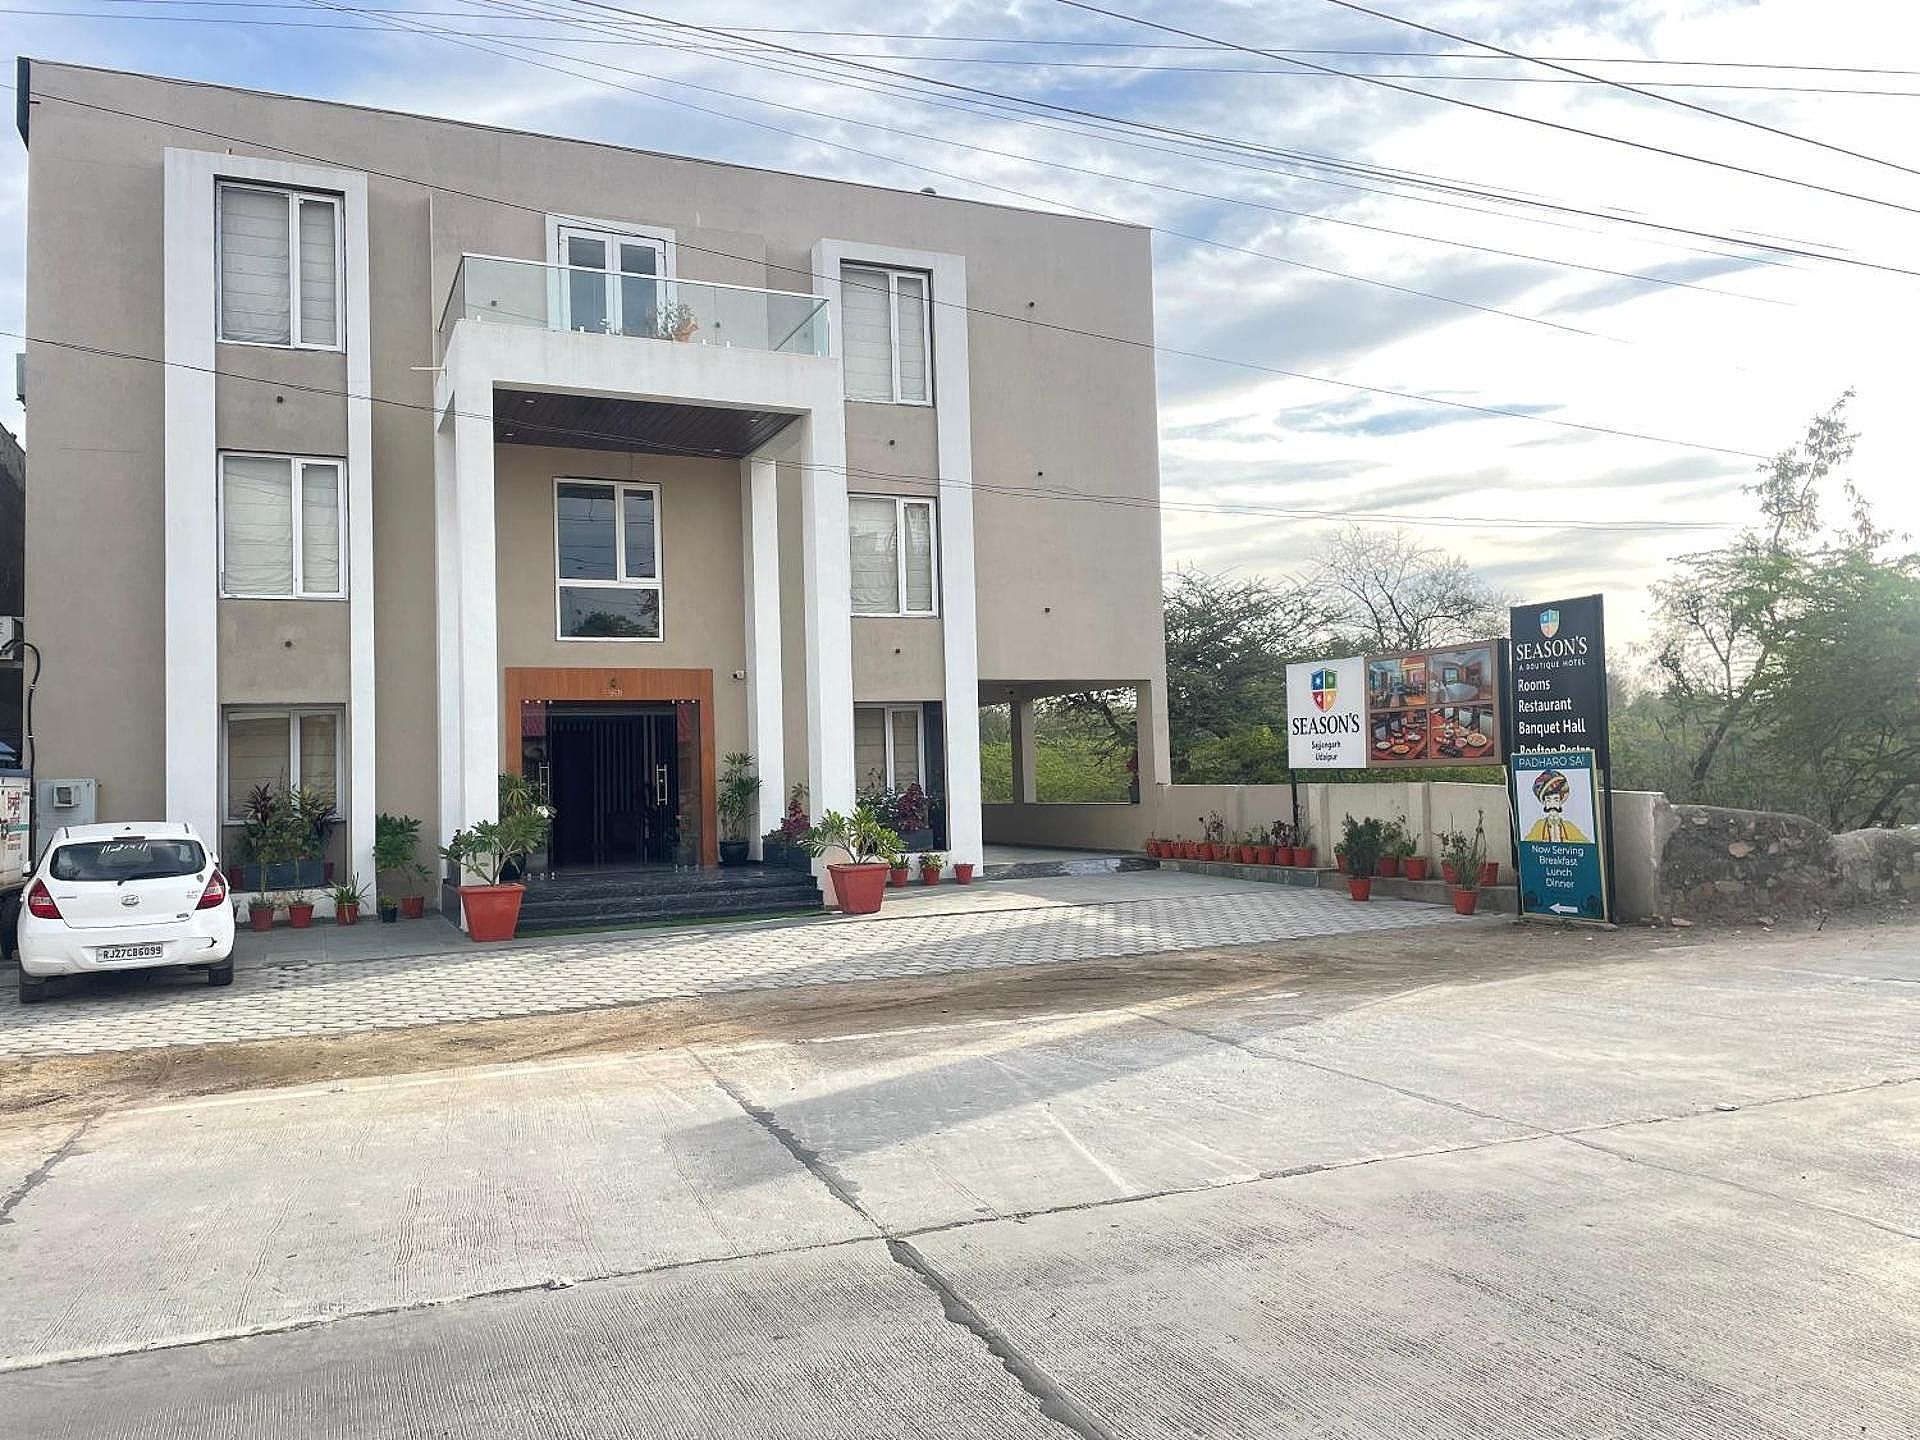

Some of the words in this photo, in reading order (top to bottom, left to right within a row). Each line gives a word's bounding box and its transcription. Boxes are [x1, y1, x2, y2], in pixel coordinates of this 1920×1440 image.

[1516, 636, 1588, 661] SEASON'S
[1562, 658, 1587, 667] HOTEL
[1518, 679, 1551, 691] Rooms
[1518, 697, 1572, 712] Restaurant
[1292, 712, 1360, 736] SEASON'S
[1518, 721, 1560, 738] Banquet
[1562, 718, 1586, 733] Hall
[1519, 756, 1568, 768] PADHARO
[1531, 845, 1551, 854] Now
[1552, 845, 1584, 857] Serving
[1539, 856, 1578, 866] Breakfast
[1546, 867, 1573, 877] Lunch
[1545, 878, 1575, 888] Dinner
